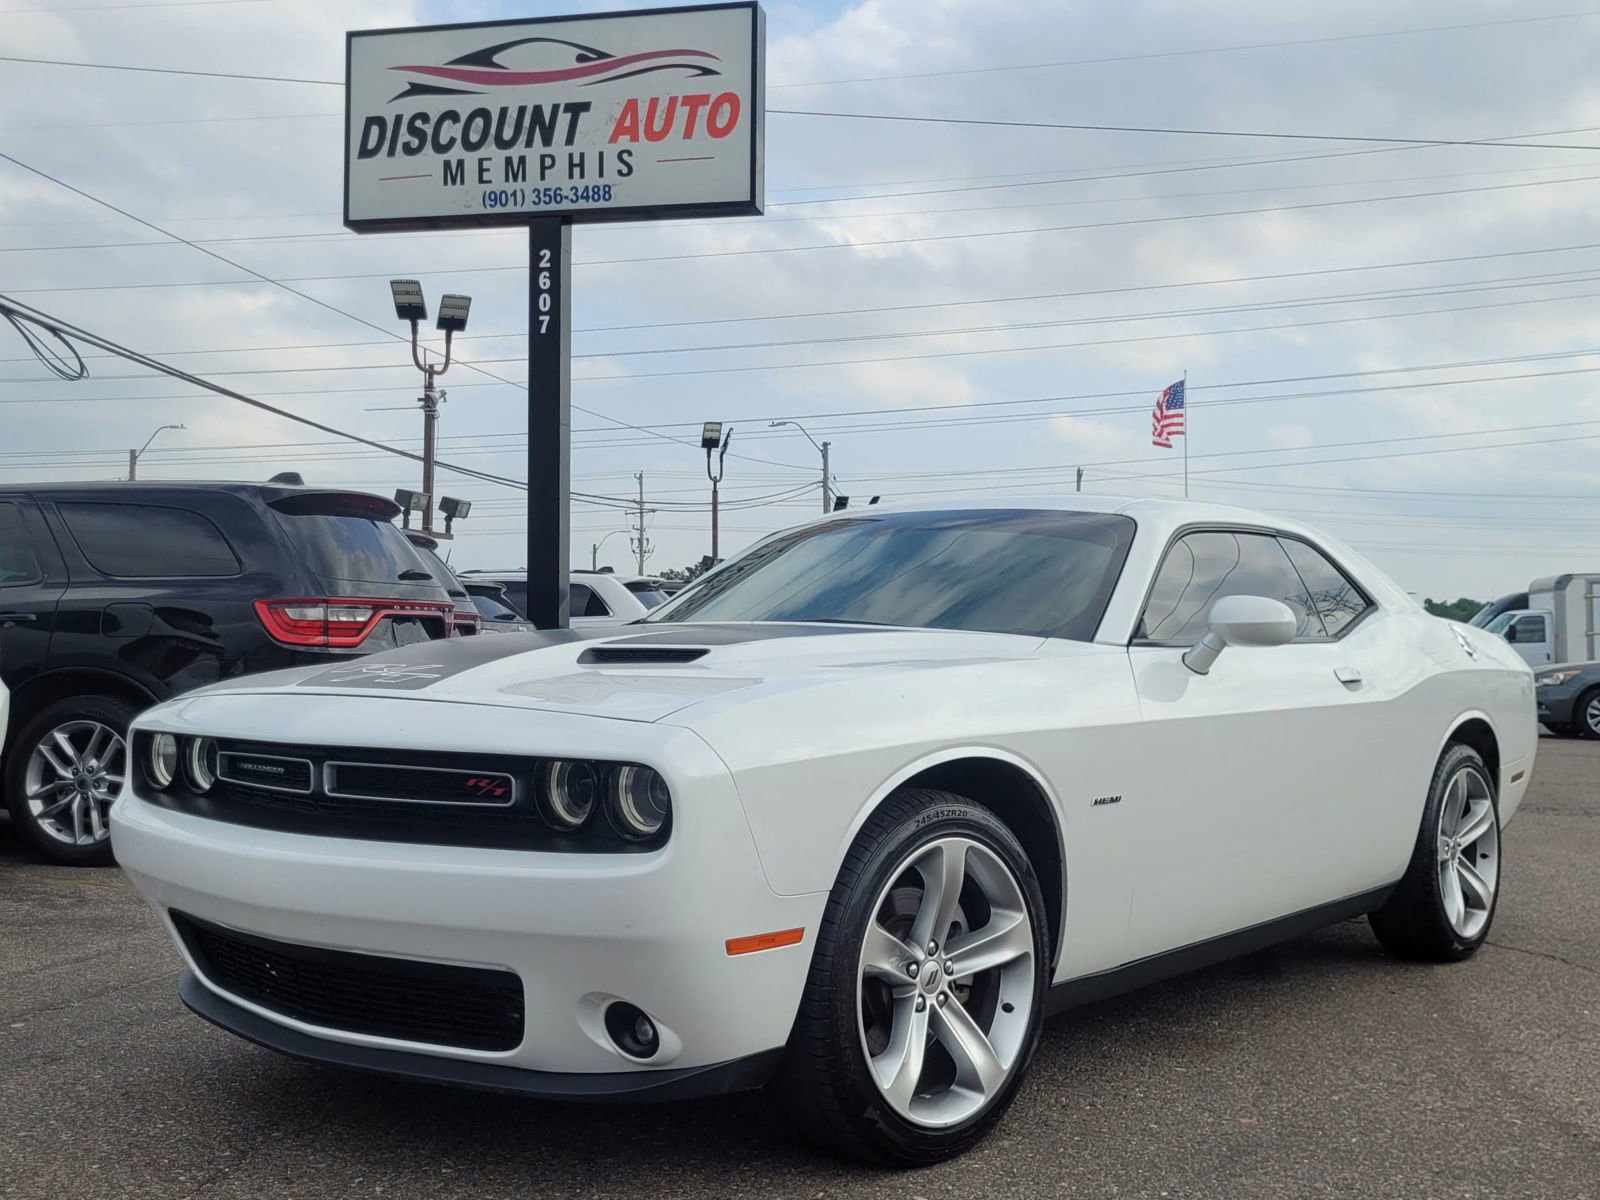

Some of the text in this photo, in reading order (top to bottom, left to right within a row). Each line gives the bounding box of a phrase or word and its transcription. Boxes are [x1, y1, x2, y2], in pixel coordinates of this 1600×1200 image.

[357, 92, 741, 160] DISCOUNT AUTO
[442, 149, 634, 187] MEMPHIS
[482, 184, 613, 209] (901) 356-3488
[538, 249, 551, 334] 2607
[465, 778, 510, 797] R/T
[1090, 795, 1122, 807] HEMI
[915, 809, 968, 828] 245/45ZR20
